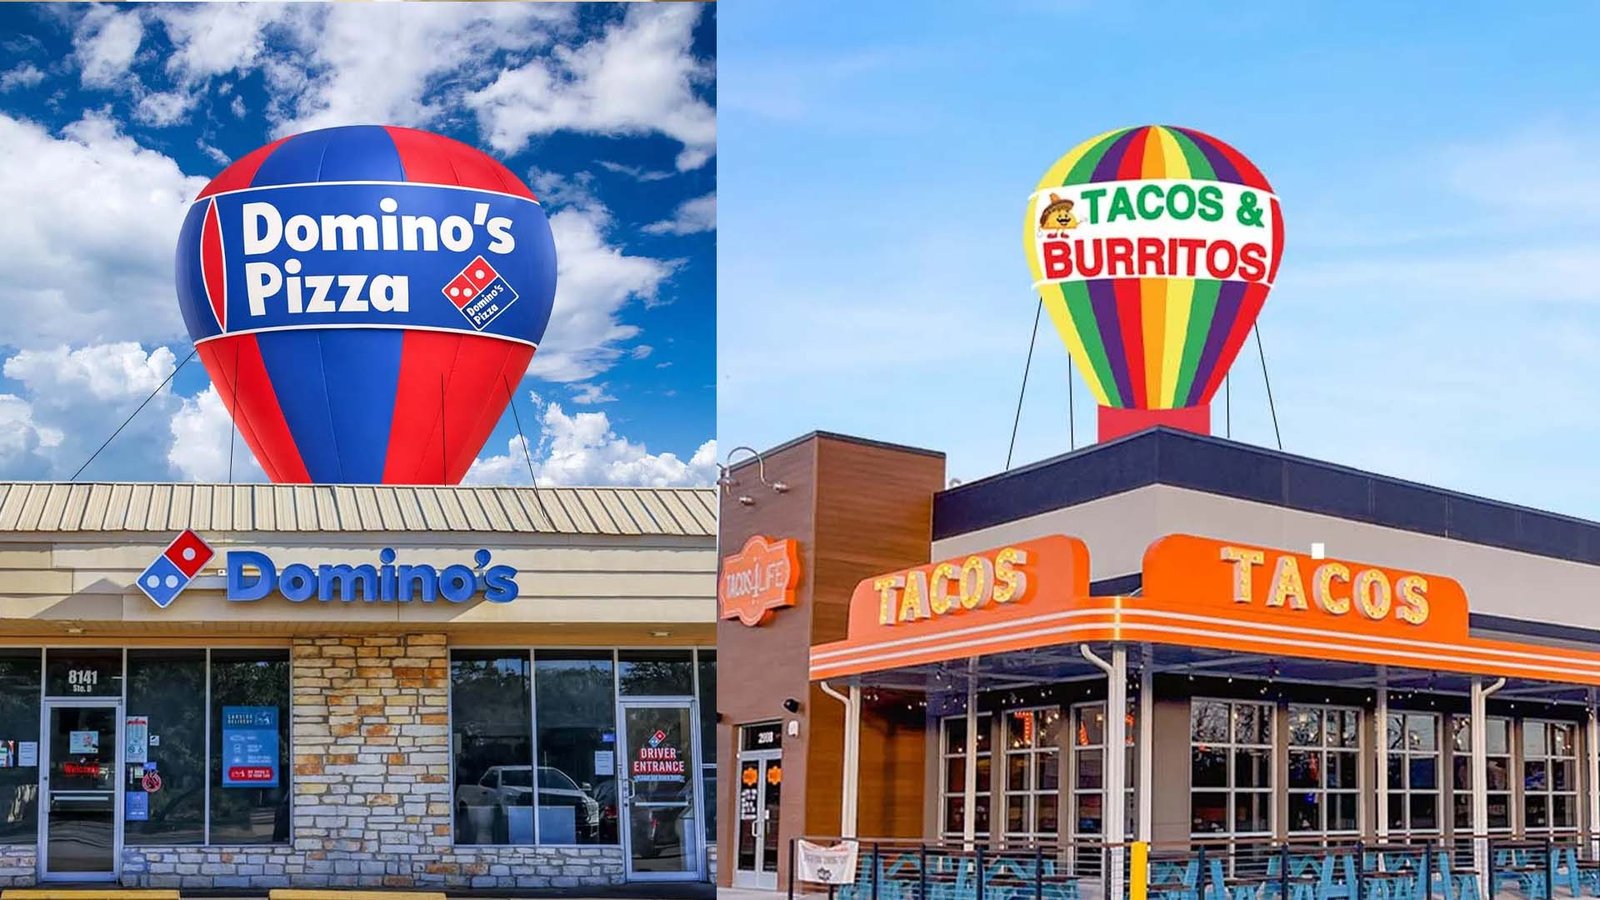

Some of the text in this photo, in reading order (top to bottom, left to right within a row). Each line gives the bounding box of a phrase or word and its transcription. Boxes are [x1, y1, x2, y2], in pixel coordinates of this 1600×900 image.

[242, 197, 516, 256] Domino's
[1081, 183, 1265, 228] TACOS &
[1043, 237, 1267, 281] BURRITOS
[244, 258, 410, 316] Pizza
[466, 284, 504, 316] Domino's
[473, 304, 499, 325] Pizza
[226, 547, 520, 604] Domino's
[874, 547, 1028, 626] TACOS
[1220, 546, 1430, 626] TACOS
[69, 670, 98, 684] 8141
[633, 761, 685, 772] ENTRANCE
[640, 748, 677, 759] DRIVER
